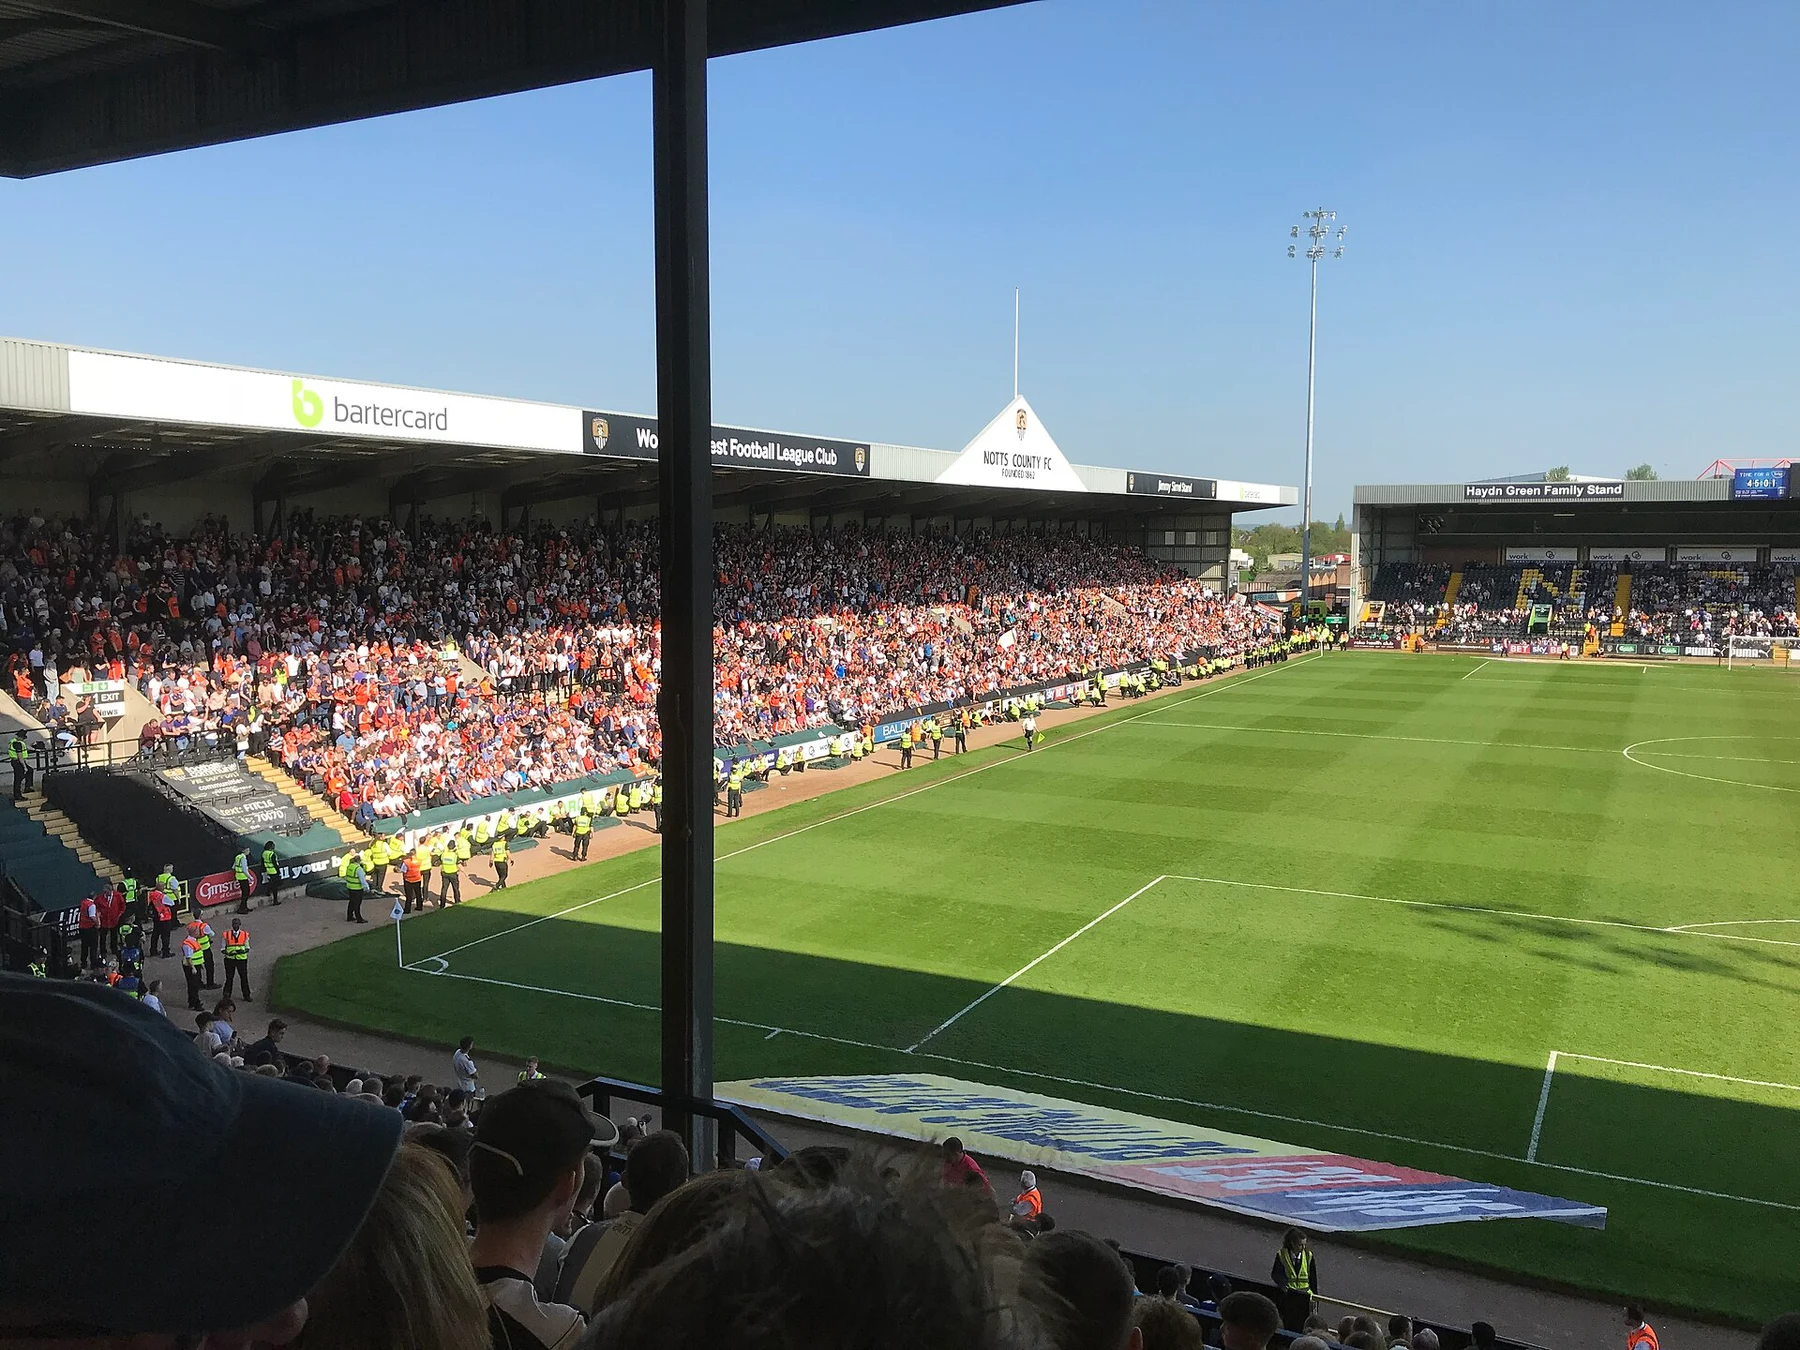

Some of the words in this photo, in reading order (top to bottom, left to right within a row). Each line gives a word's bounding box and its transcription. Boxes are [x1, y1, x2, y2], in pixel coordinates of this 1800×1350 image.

[334, 396, 448, 431] bartercard
[636, 427, 658, 449] Wo
[710, 439, 728, 456] est
[730, 438, 775, 460] Football
[776, 443, 814, 466] League
[815, 447, 838, 466] Club
[983, 450, 1009, 467] NOTTS
[1012, 454, 1041, 469] COUNTY
[1043, 457, 1052, 471] FC
[1002, 468, 1025, 479] FOUNDED
[1466, 485, 1503, 498] Haydn
[1506, 485, 1541, 496] Green
[1544, 484, 1584, 498] Family
[1587, 484, 1623, 495] Stand
[1492, 644, 1503, 652] sk
[1510, 645, 1529, 653] BET
[1532, 645, 1547, 655] sky
[1550, 646, 1562, 654] BE
[1685, 646, 1714, 656] PUMA
[101, 692, 120, 702] EXIT
[219, 806, 244, 816] text:
[254, 810, 284, 823] 70070
[292, 859, 330, 879] your
[199, 880, 254, 900] Ginste
[1142, 1161, 1402, 1191] BET
